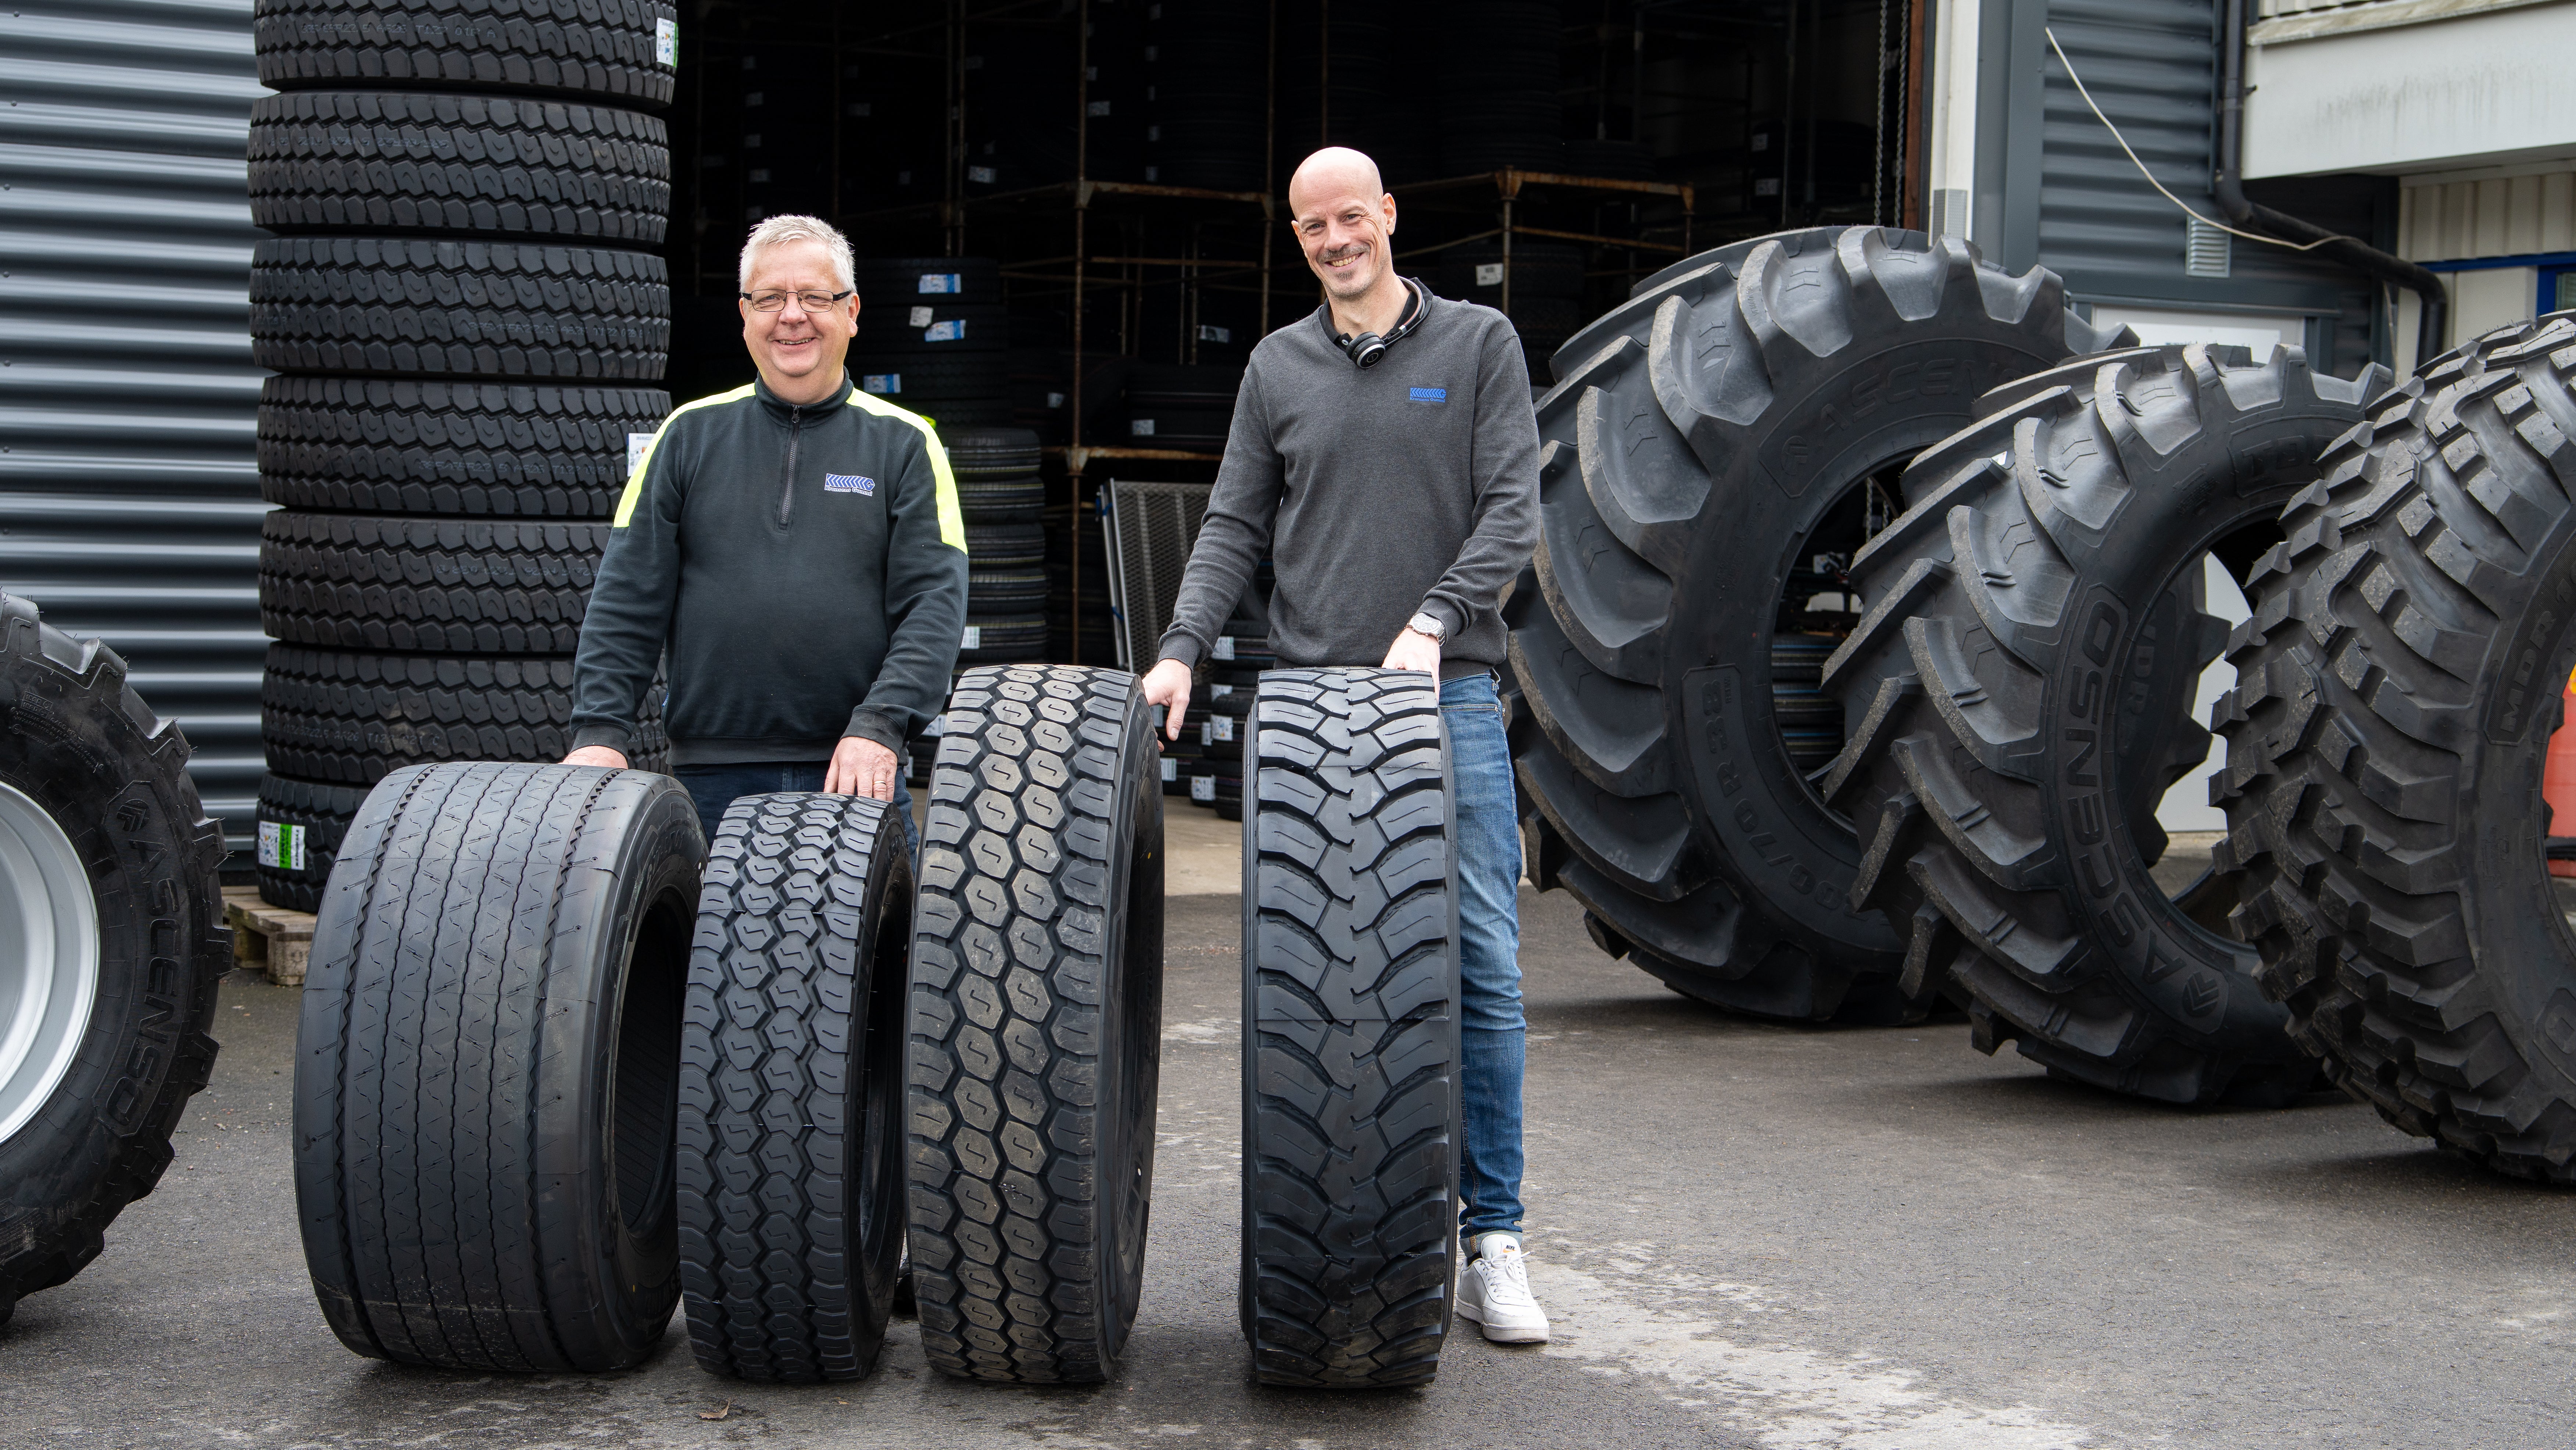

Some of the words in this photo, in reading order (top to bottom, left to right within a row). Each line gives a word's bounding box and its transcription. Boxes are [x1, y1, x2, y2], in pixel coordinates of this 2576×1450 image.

[852, 487, 873, 497] Gummi
[2065, 599, 2186, 986] ASCENSO
[106, 839, 180, 1126] ASCENSO
